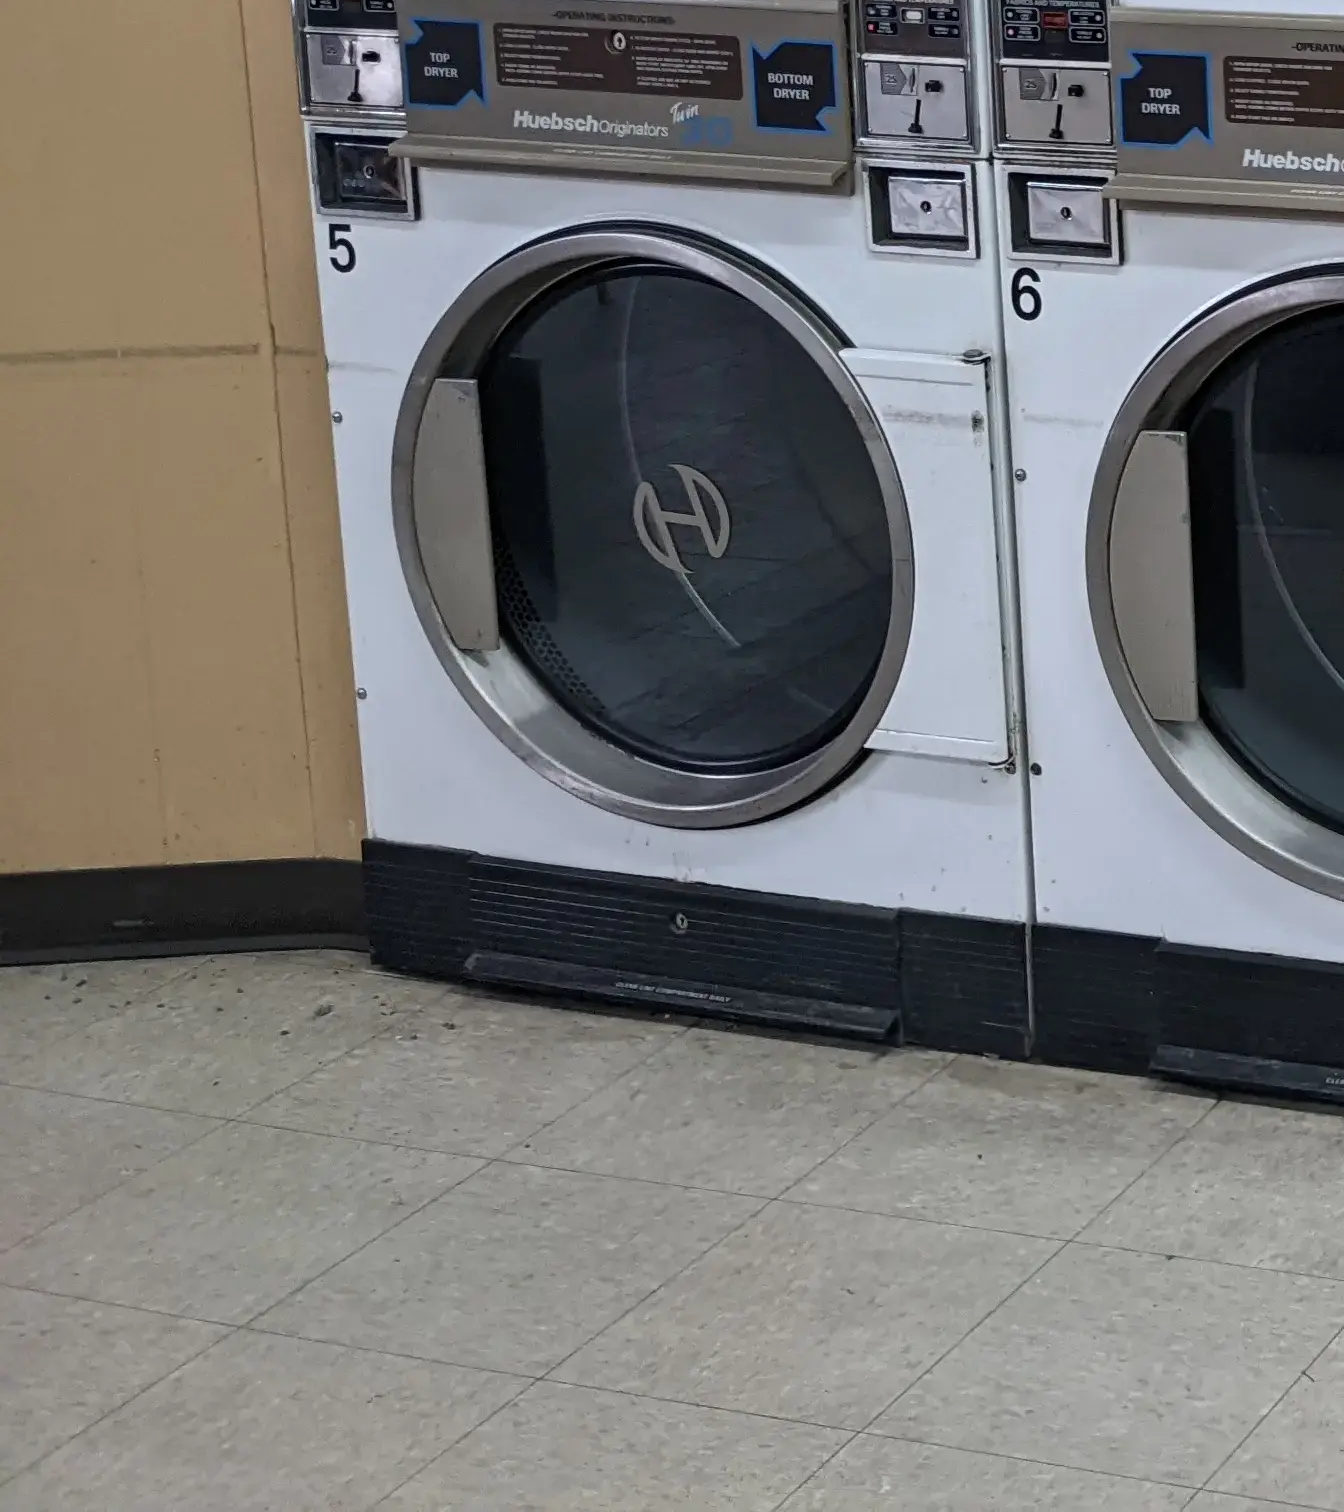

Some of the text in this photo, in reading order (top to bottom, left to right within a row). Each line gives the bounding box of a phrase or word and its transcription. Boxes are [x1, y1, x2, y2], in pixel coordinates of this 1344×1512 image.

[430, 51, 450, 63] TOP
[424, 66, 459, 79] DRYER
[767, 73, 813, 86] BOTTOM
[773, 87, 810, 100] DRYER
[1149, 88, 1172, 99] TOP
[669, 102, 699, 124] Twin
[1141, 102, 1180, 115] DRYER
[329, 224, 356, 273] 5
[1011, 267, 1041, 320] 6
